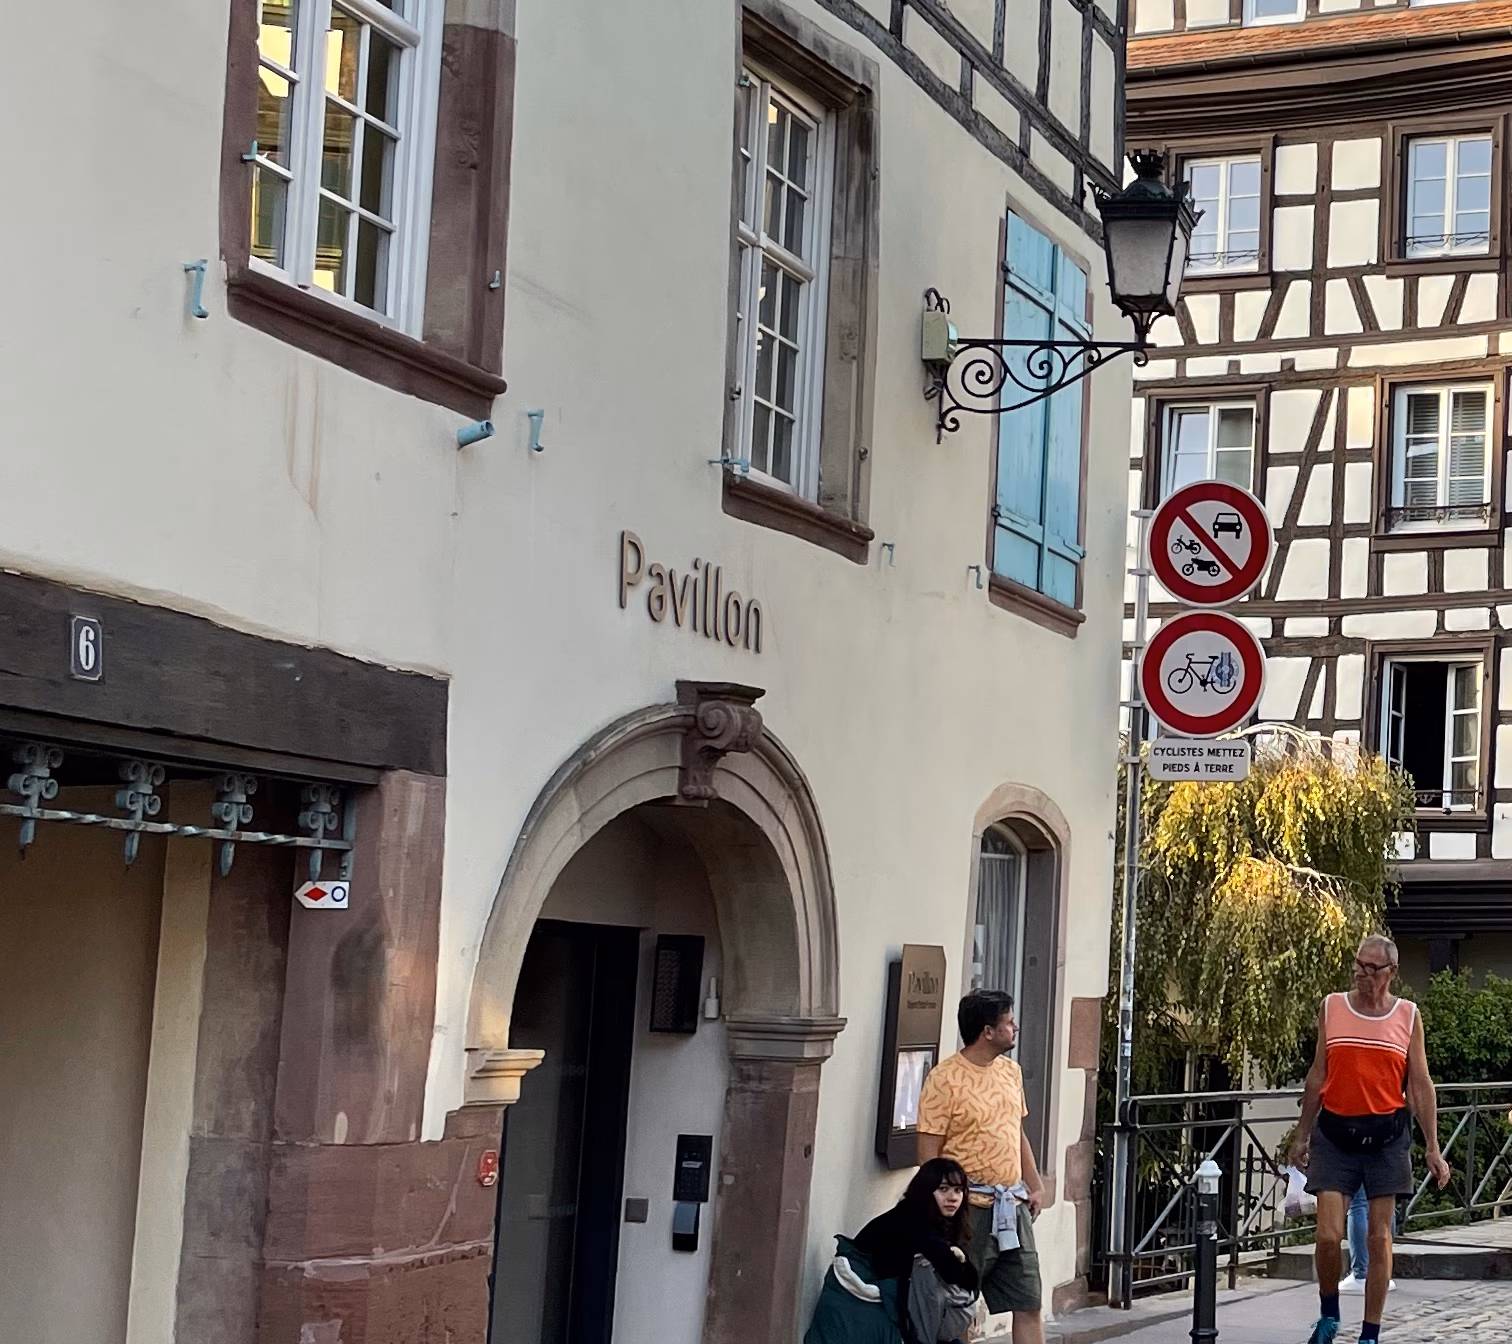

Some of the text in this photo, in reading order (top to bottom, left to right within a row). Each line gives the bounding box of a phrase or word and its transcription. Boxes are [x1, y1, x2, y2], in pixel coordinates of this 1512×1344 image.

[618, 529, 763, 654] Pavillon
[79, 626, 95, 670] 6
[1153, 747, 1245, 757] CYCLISTES METTEZ
[1162, 762, 1191, 773] PIEDS
[1204, 763, 1234, 773] TERRE
